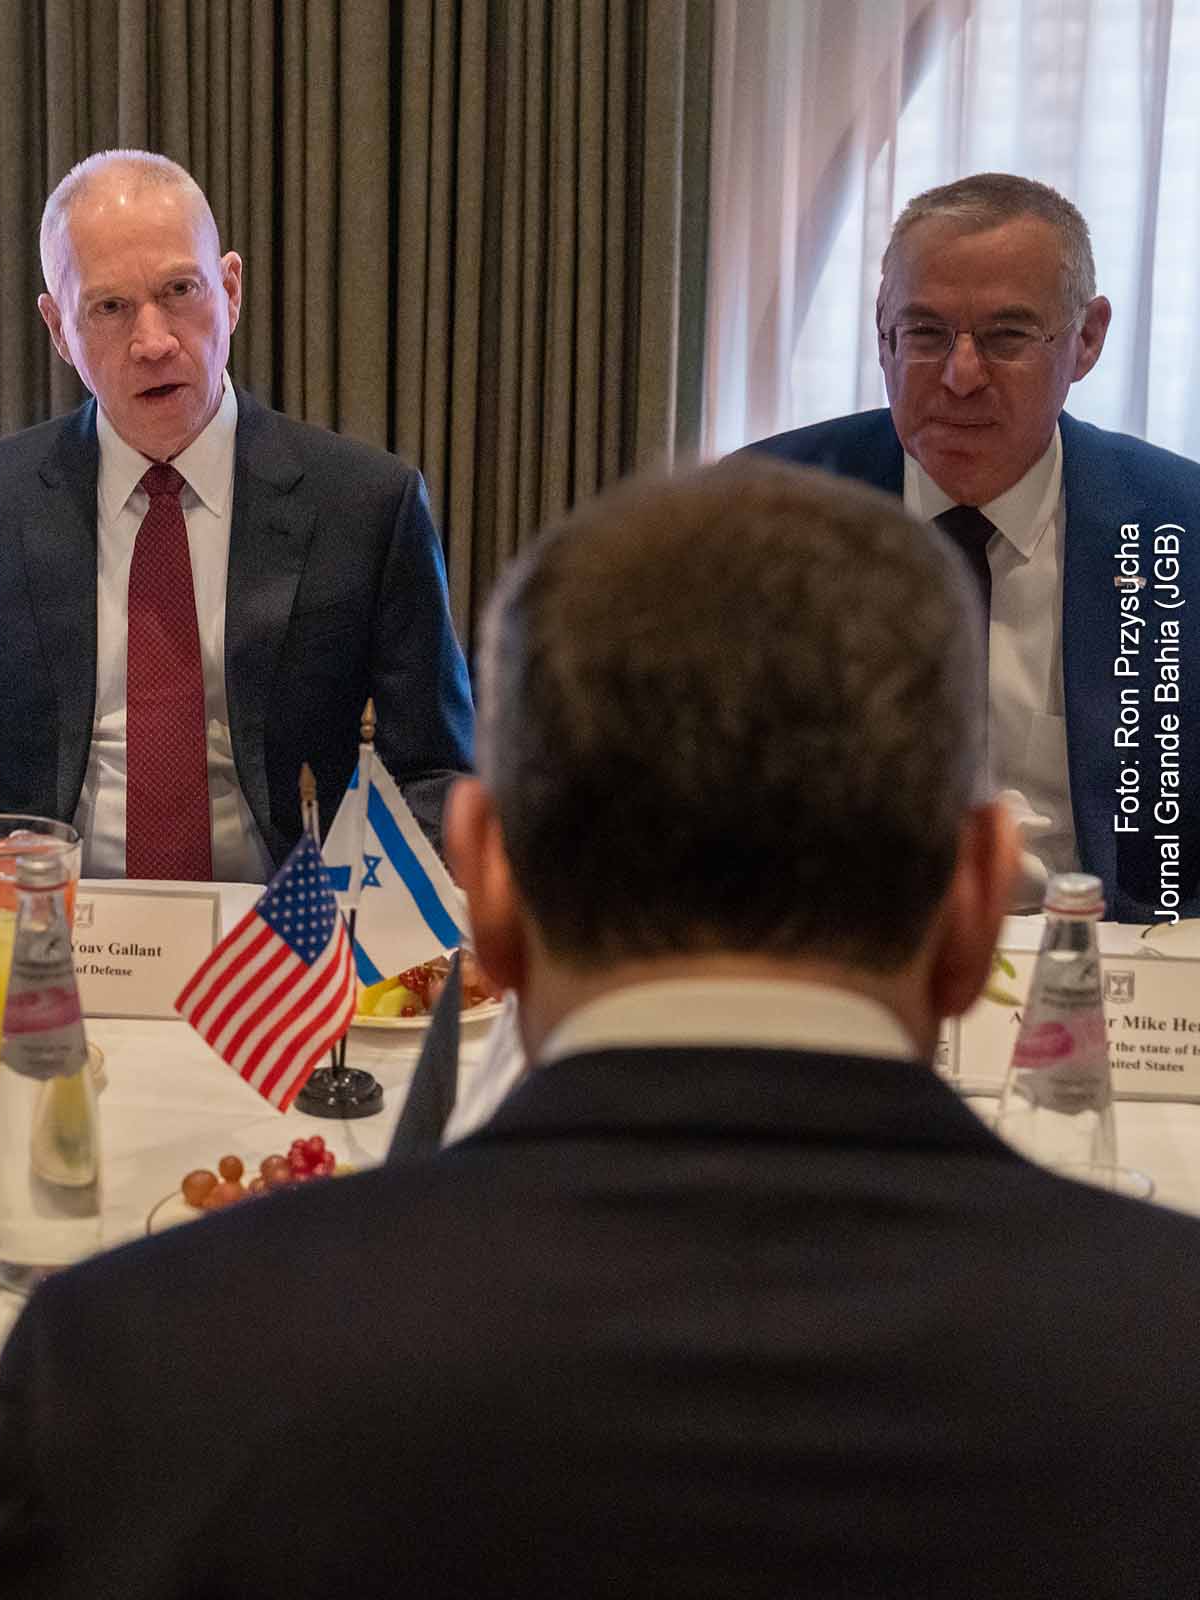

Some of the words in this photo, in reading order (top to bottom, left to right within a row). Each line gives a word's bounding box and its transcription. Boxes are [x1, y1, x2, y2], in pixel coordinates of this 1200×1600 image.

[108, 942, 162, 957] Gallant
[75, 965, 88, 975] of
[90, 965, 133, 977] Defense
[1122, 1015, 1167, 1031] Mike
[1116, 1042, 1136, 1053] the
[1140, 1044, 1170, 1055] state
[1174, 1044, 1188, 1055] of
[1143, 1061, 1185, 1073] States
